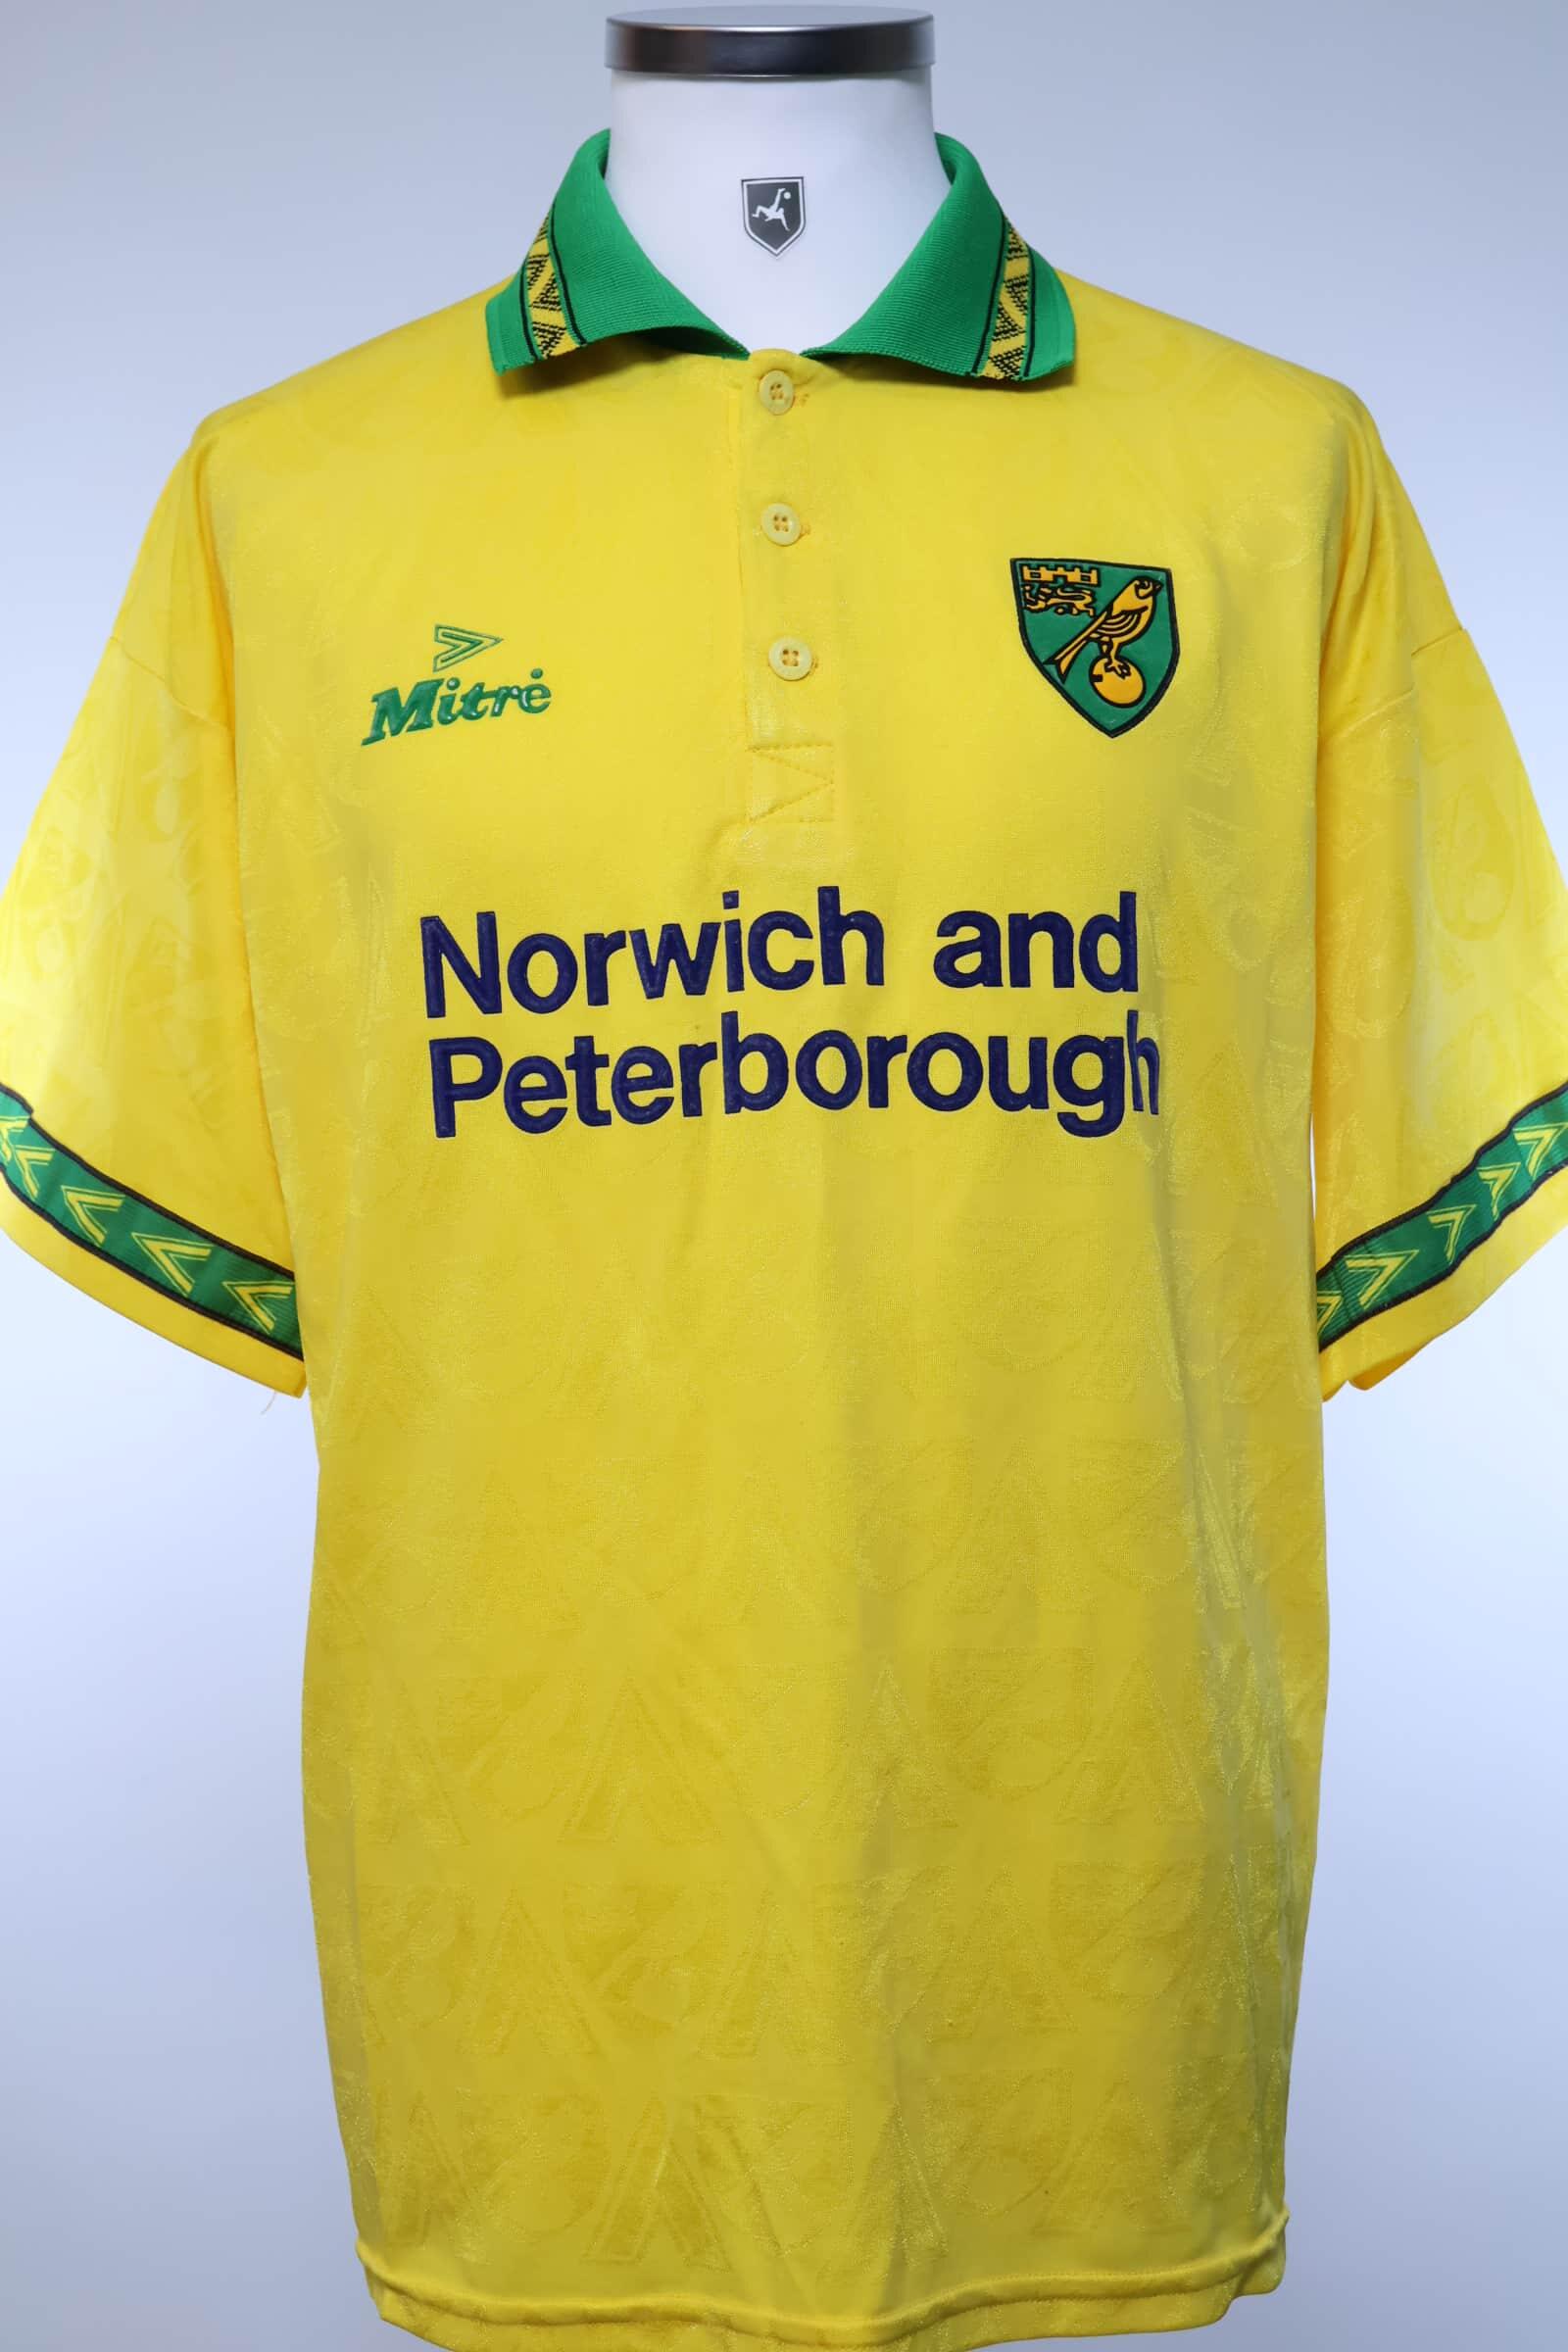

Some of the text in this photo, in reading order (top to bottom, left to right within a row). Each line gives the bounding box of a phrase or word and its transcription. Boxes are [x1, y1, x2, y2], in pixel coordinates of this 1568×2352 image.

[419, 886, 1140, 1019] Norwich and
[428, 1009, 1161, 1139] Peterborough
